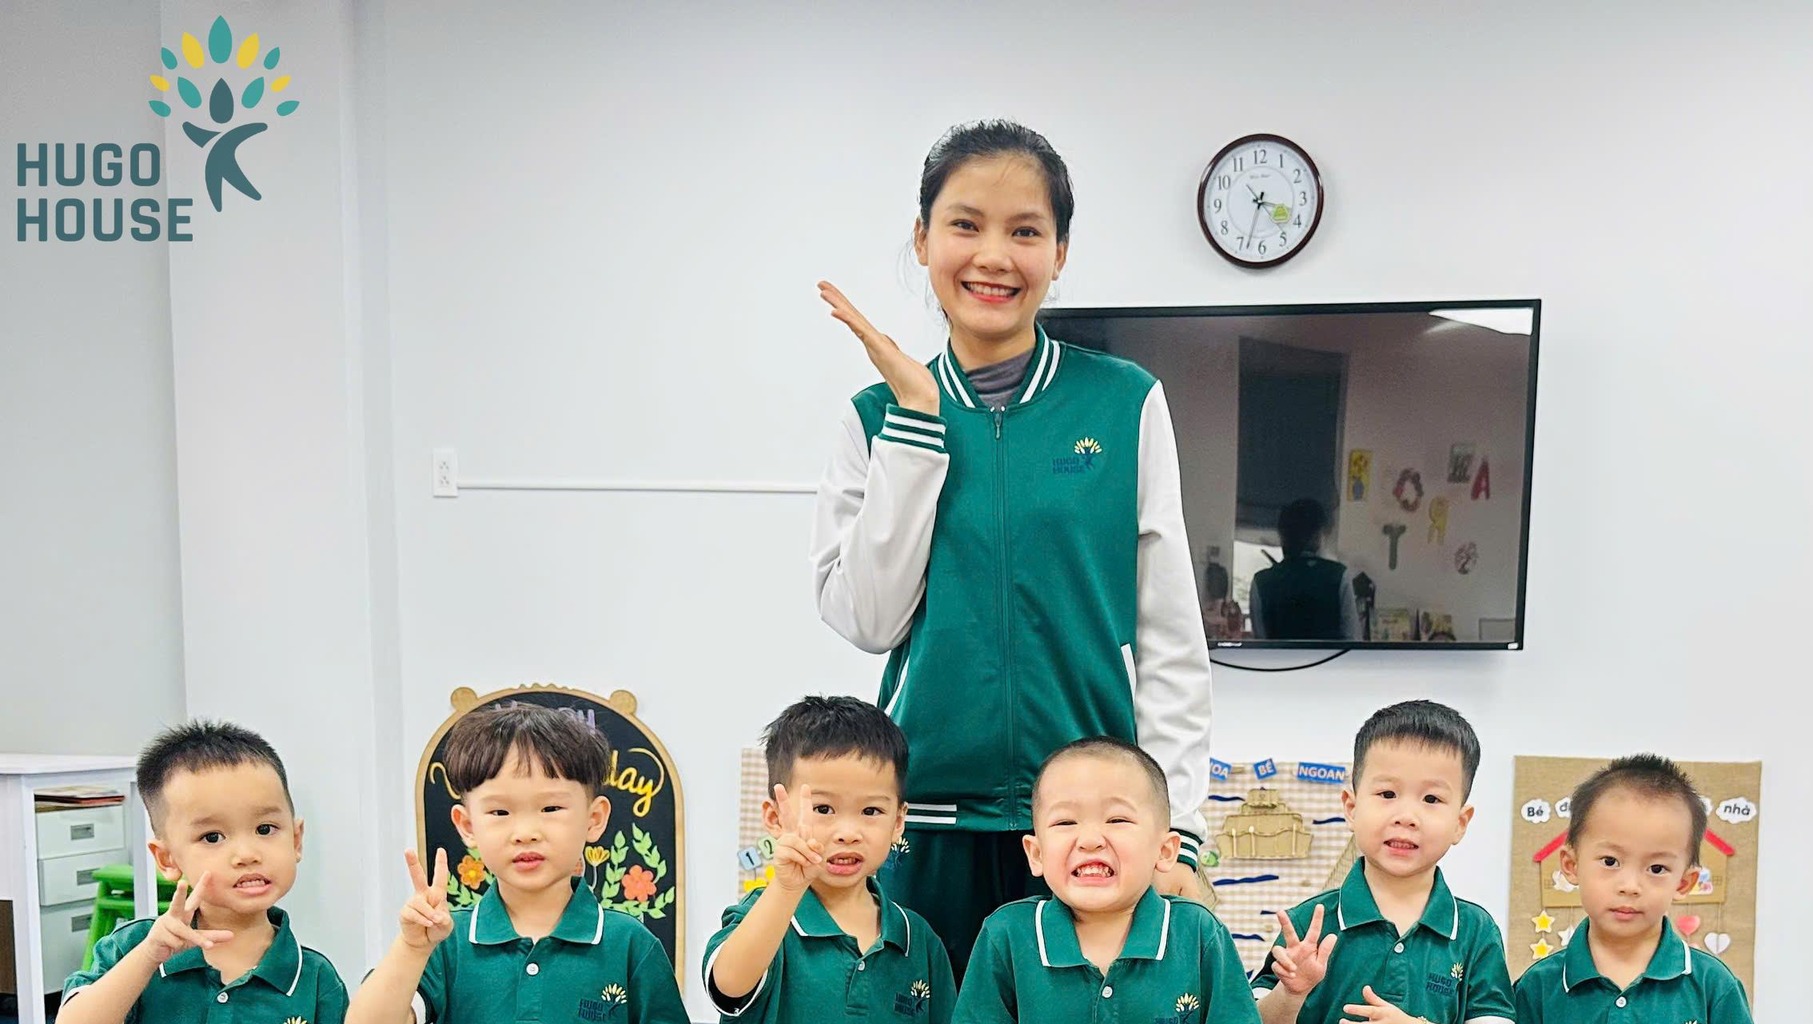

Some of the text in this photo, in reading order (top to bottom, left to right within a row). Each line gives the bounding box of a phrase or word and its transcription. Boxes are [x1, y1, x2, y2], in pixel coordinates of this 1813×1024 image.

[1253, 149, 1267, 164] 12
[1279, 154, 1284, 168] 1
[1233, 157, 1243, 172] 11
[1218, 175, 1231, 190] 10
[1293, 168, 1302, 183] 2
[1214, 198, 1222, 214] 9
[1300, 191, 1307, 206] 3
[1221, 220, 1229, 235] 8
[1293, 214, 1302, 228] 4
[1237, 236, 1244, 250] 7
[1279, 231, 1287, 247] 5
[1258, 240, 1267, 255] 6
[1258, 759, 1274, 776] BÉ
[1299, 766, 1345, 780] NGOAN
[1527, 805, 1544, 817] Bé
[1724, 803, 1751, 816] nhà
[745, 851, 755, 866] 1
